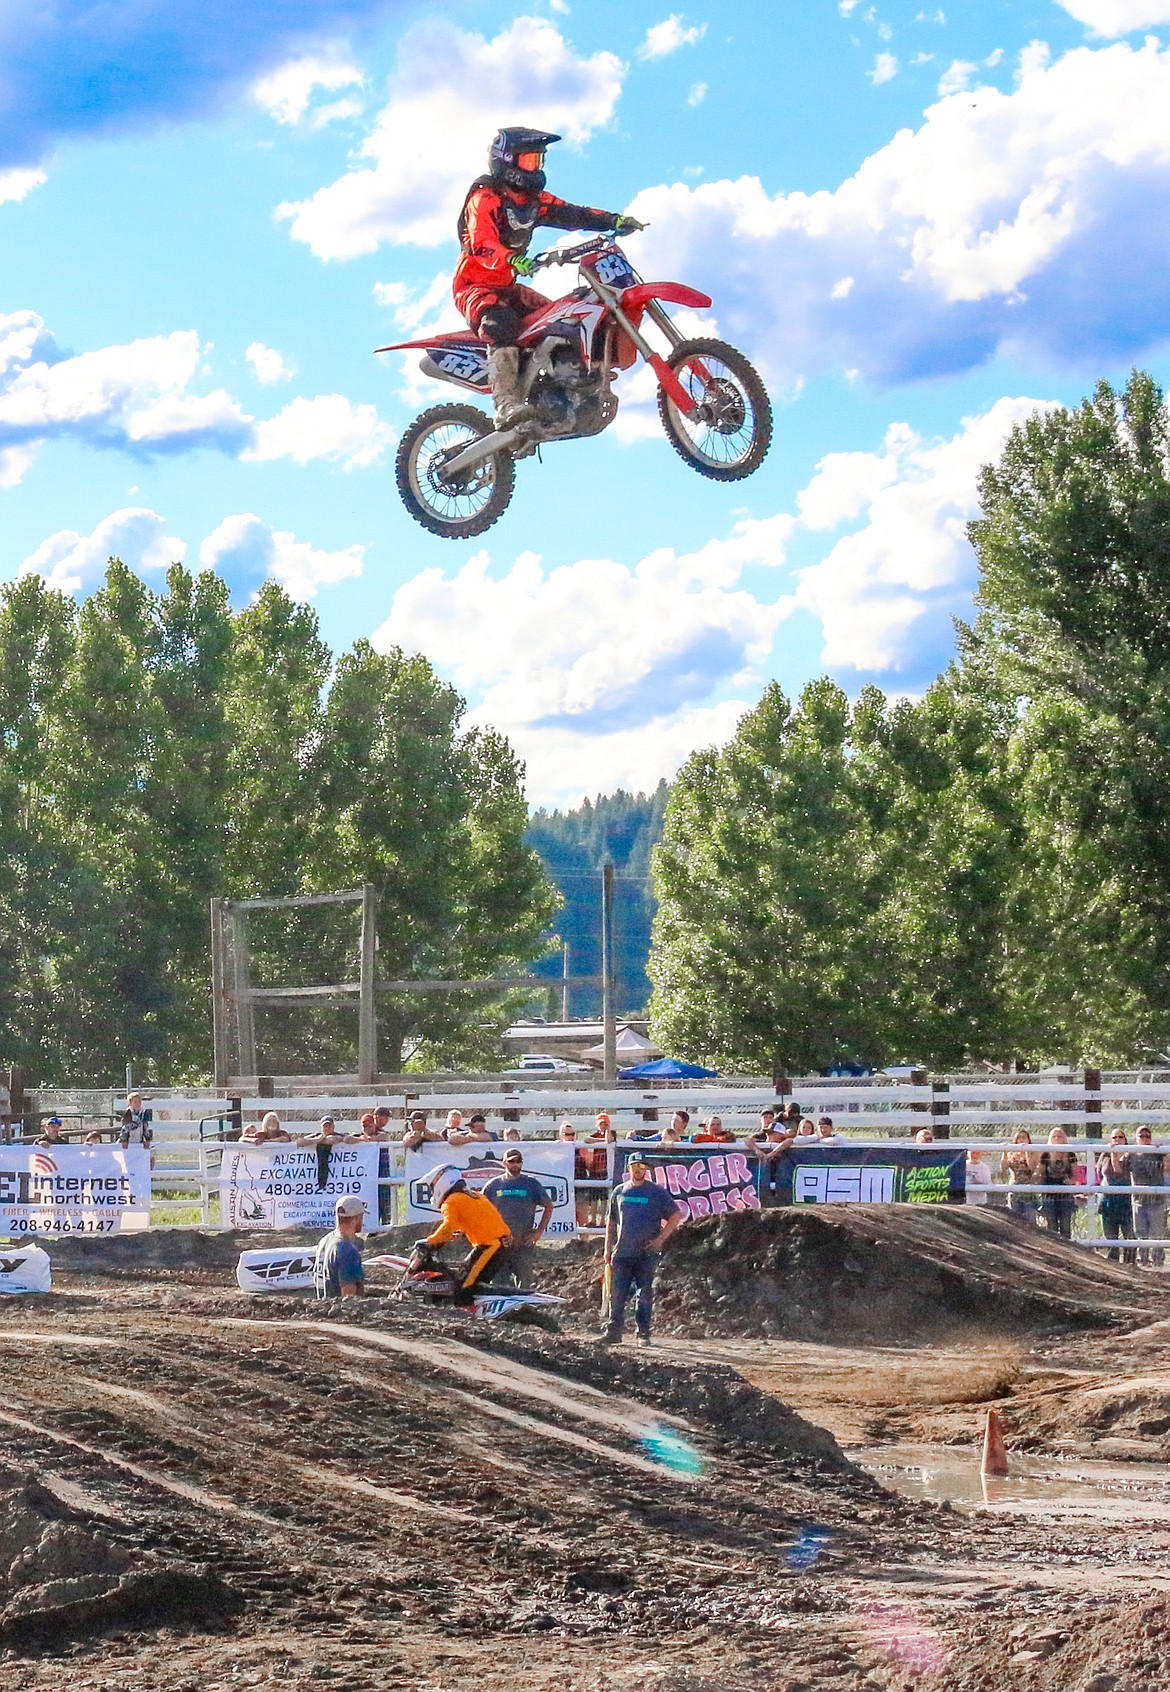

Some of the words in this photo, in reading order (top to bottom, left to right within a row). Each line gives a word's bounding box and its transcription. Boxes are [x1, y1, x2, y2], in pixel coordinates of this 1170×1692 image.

[273, 1153, 316, 1165] AUSTIN
[327, 1151, 358, 1163] ONES
[260, 1167, 338, 1179] EXCAVATIN,
[341, 1166, 368, 1178] LLC.
[622, 1152, 753, 1195] URGER
[907, 1165, 950, 1180] ACTION
[34, 1173, 130, 1191] internet
[265, 1181, 361, 1196] 480-282-3319
[795, 1167, 895, 1203] ASM
[905, 1177, 951, 1192] SPORTS
[44, 1193, 136, 1205] northwest
[907, 1189, 949, 1203] MEDIA
[277, 1201, 318, 1209] COMMERCIAL
[2, 1208, 29, 1216] FIBER
[39, 1208, 84, 1217] WIRELESS
[92, 1208, 122, 1217] CABLE
[283, 1211, 321, 1219] EXCAVATION
[10, 1219, 114, 1232] 208-946-4147
[303, 1220, 336, 1228] SERVICES
